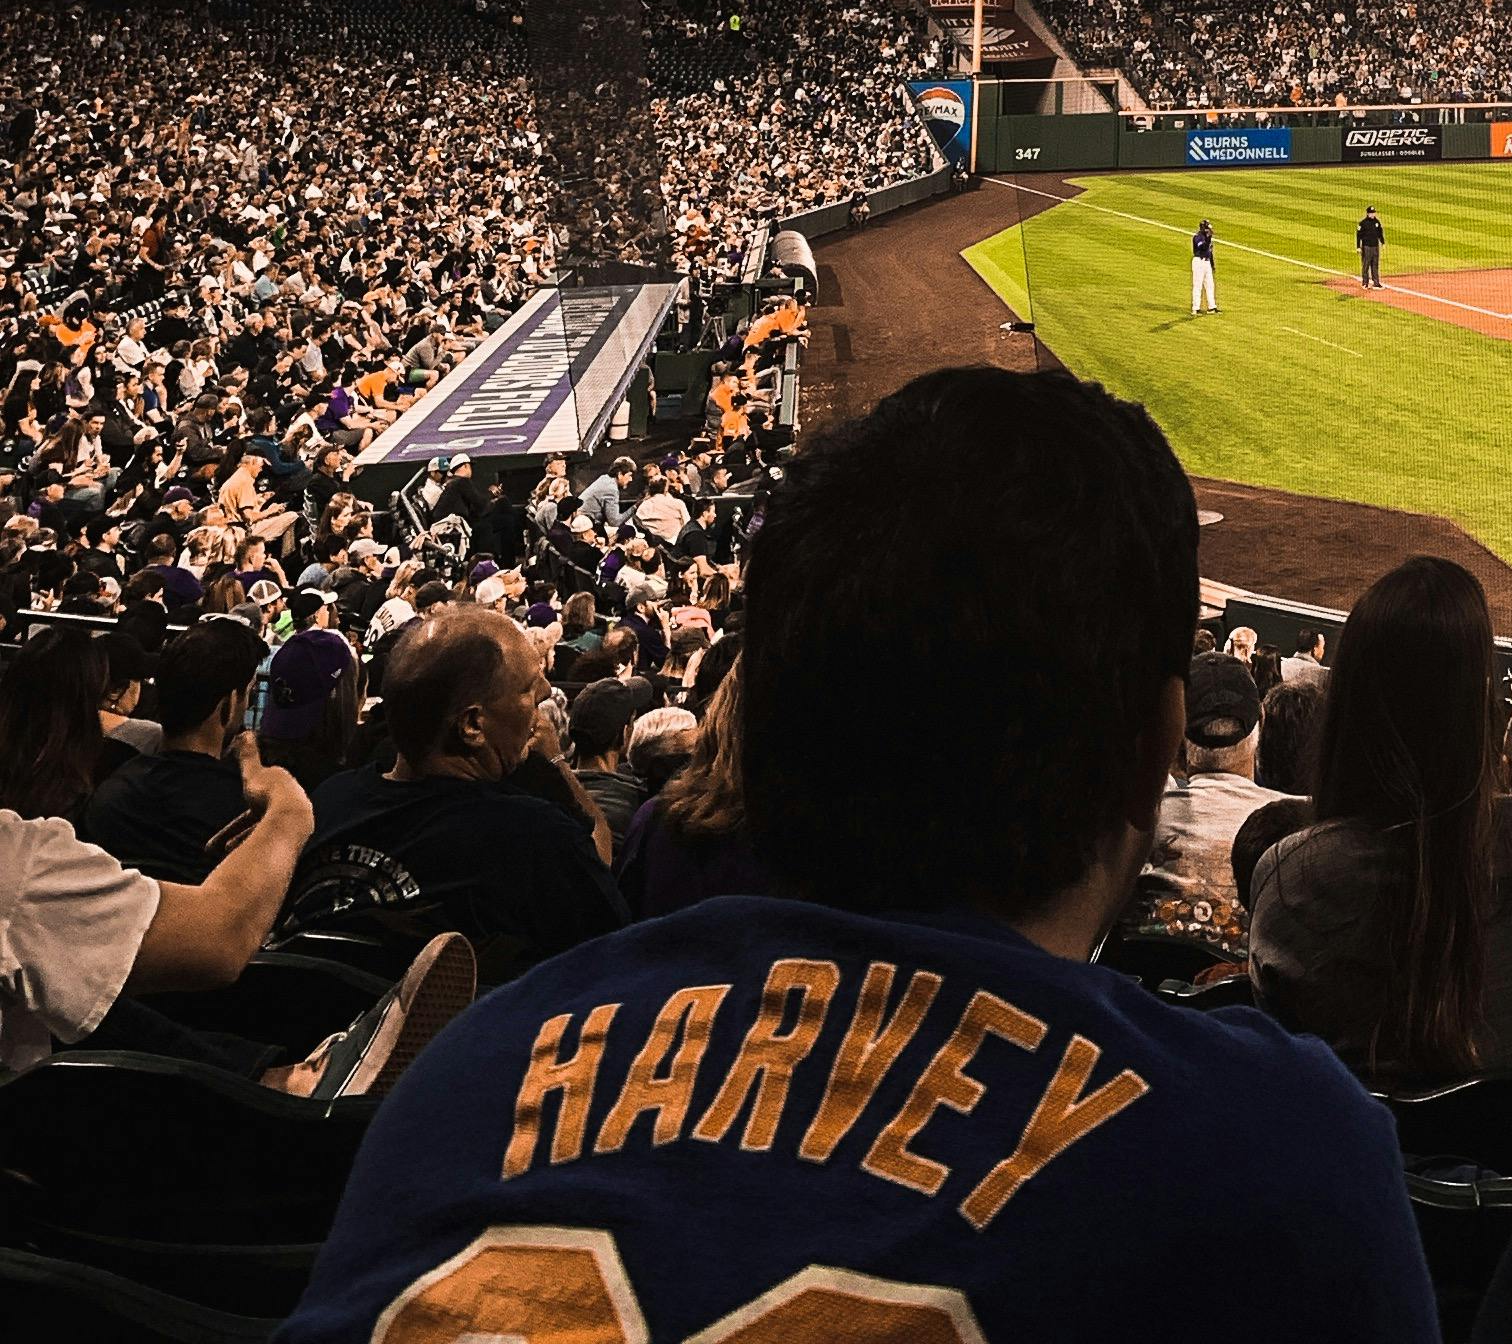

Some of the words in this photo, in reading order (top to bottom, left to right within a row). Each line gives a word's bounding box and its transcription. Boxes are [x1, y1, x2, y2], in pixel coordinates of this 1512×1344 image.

[1375, 136, 1437, 146] NERVE
[1376, 128, 1428, 139] OPTIC
[1203, 136, 1249, 148] BURNS
[1014, 148, 1041, 160] 347
[516, 336, 592, 351] TO
[479, 350, 580, 390] COORS
[437, 389, 551, 432] FIELD
[348, 844, 385, 867] THE
[501, 958, 1151, 1230] HARVEY
